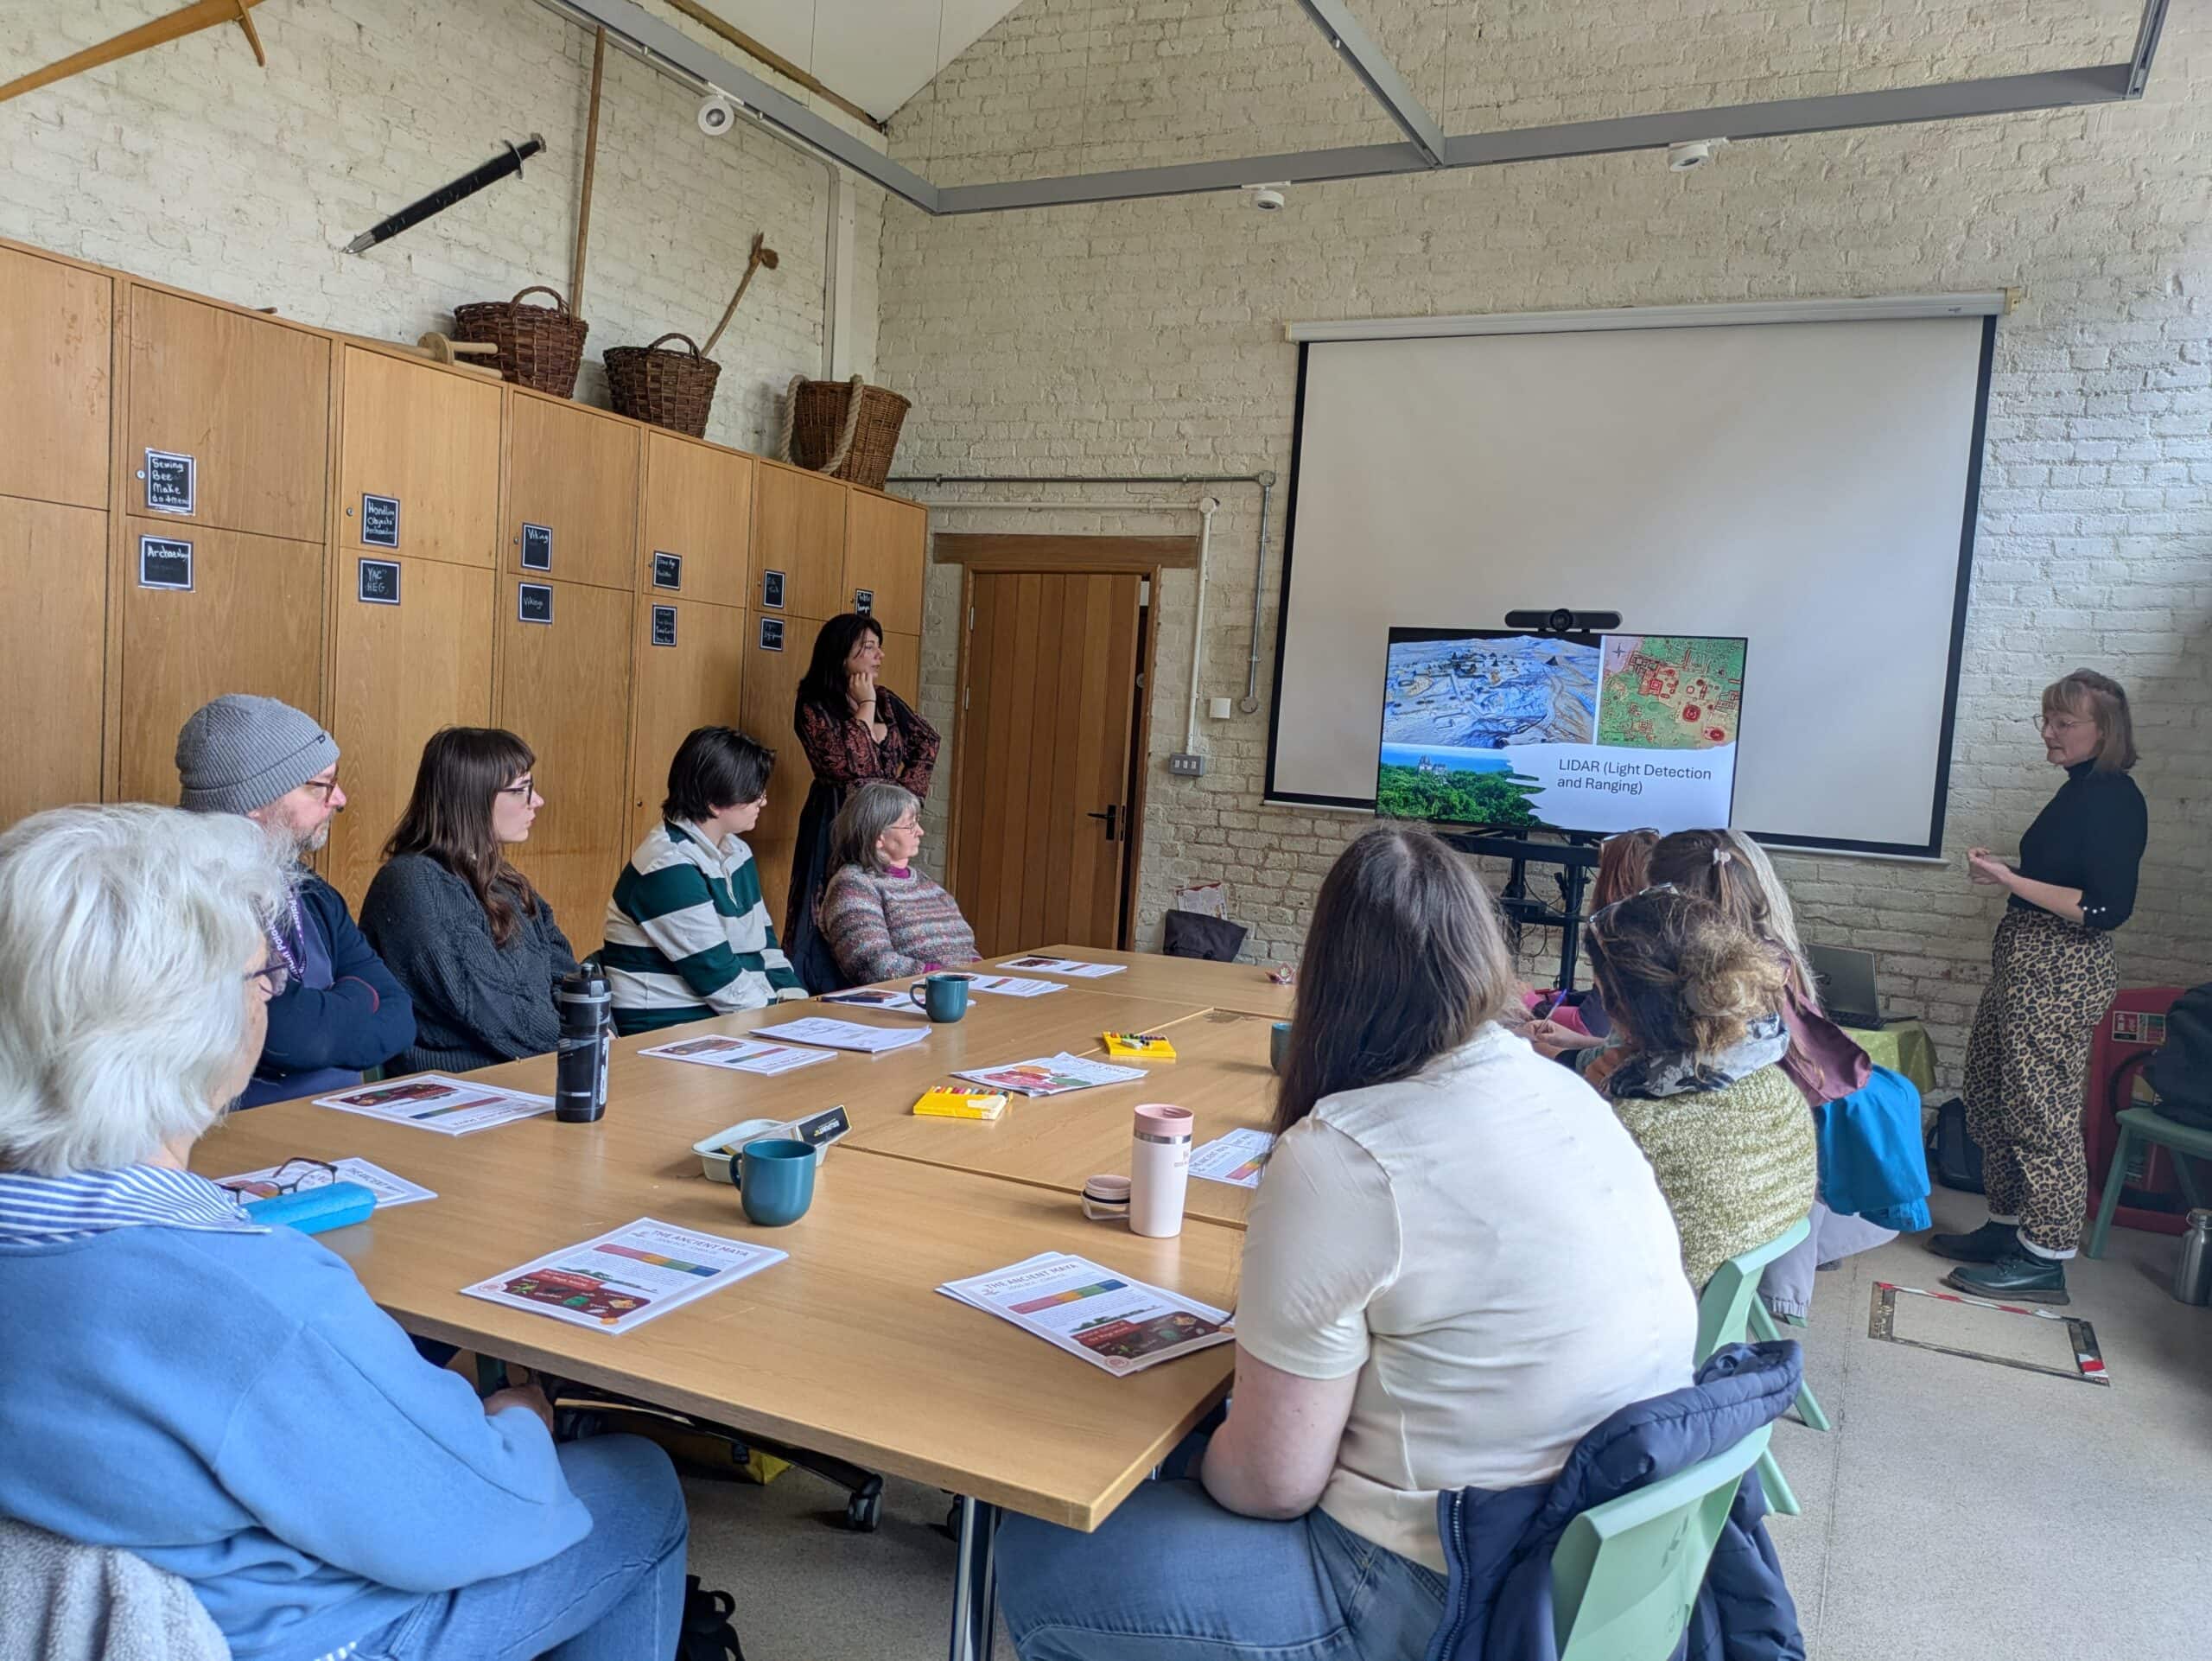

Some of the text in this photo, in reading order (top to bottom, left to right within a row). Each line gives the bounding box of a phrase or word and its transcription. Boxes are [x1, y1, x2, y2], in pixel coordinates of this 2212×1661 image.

[152, 458, 184, 473] Sewing
[152, 471, 173, 481] Bee
[152, 484, 181, 495] Make
[1559, 758, 1713, 780] LIDAR (Light Detection
[1557, 777, 1643, 795] and Ranging)
[270, 923, 286, 951] Palac
[672, 1235, 721, 1250] ANCIENT
[1007, 1270, 1050, 1285] ANCIENT
